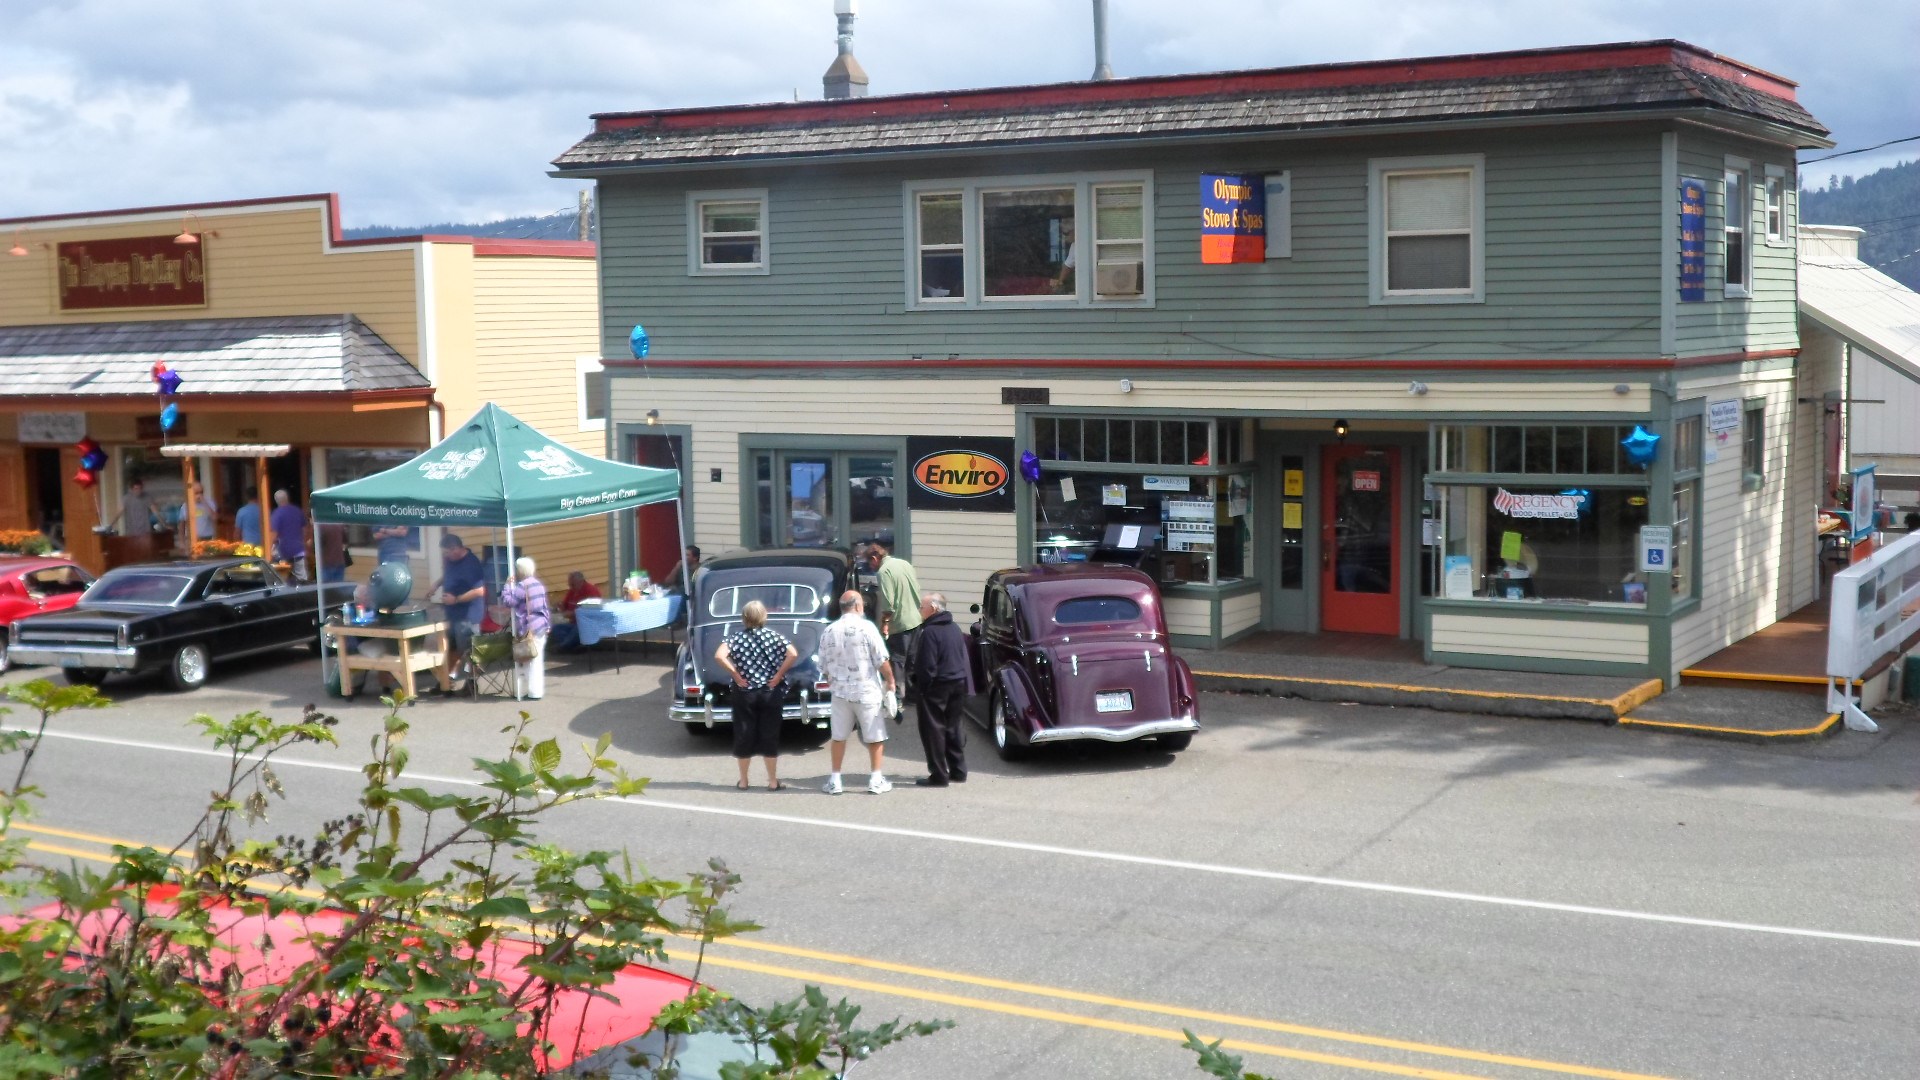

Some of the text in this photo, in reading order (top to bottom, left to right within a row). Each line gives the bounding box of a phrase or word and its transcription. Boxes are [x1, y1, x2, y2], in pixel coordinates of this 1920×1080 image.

[1214, 178, 1252, 204] Olympic
[1203, 207, 1264, 233] Stove & Spas
[925, 462, 1000, 486] Enviro
[1355, 478, 1377, 490] OPEN
[334, 502, 478, 519] The Ultimate Cooking Experience
[560, 498, 574, 511] Big
[575, 495, 600, 507] Green
[1512, 495, 1578, 510] REGENCY
